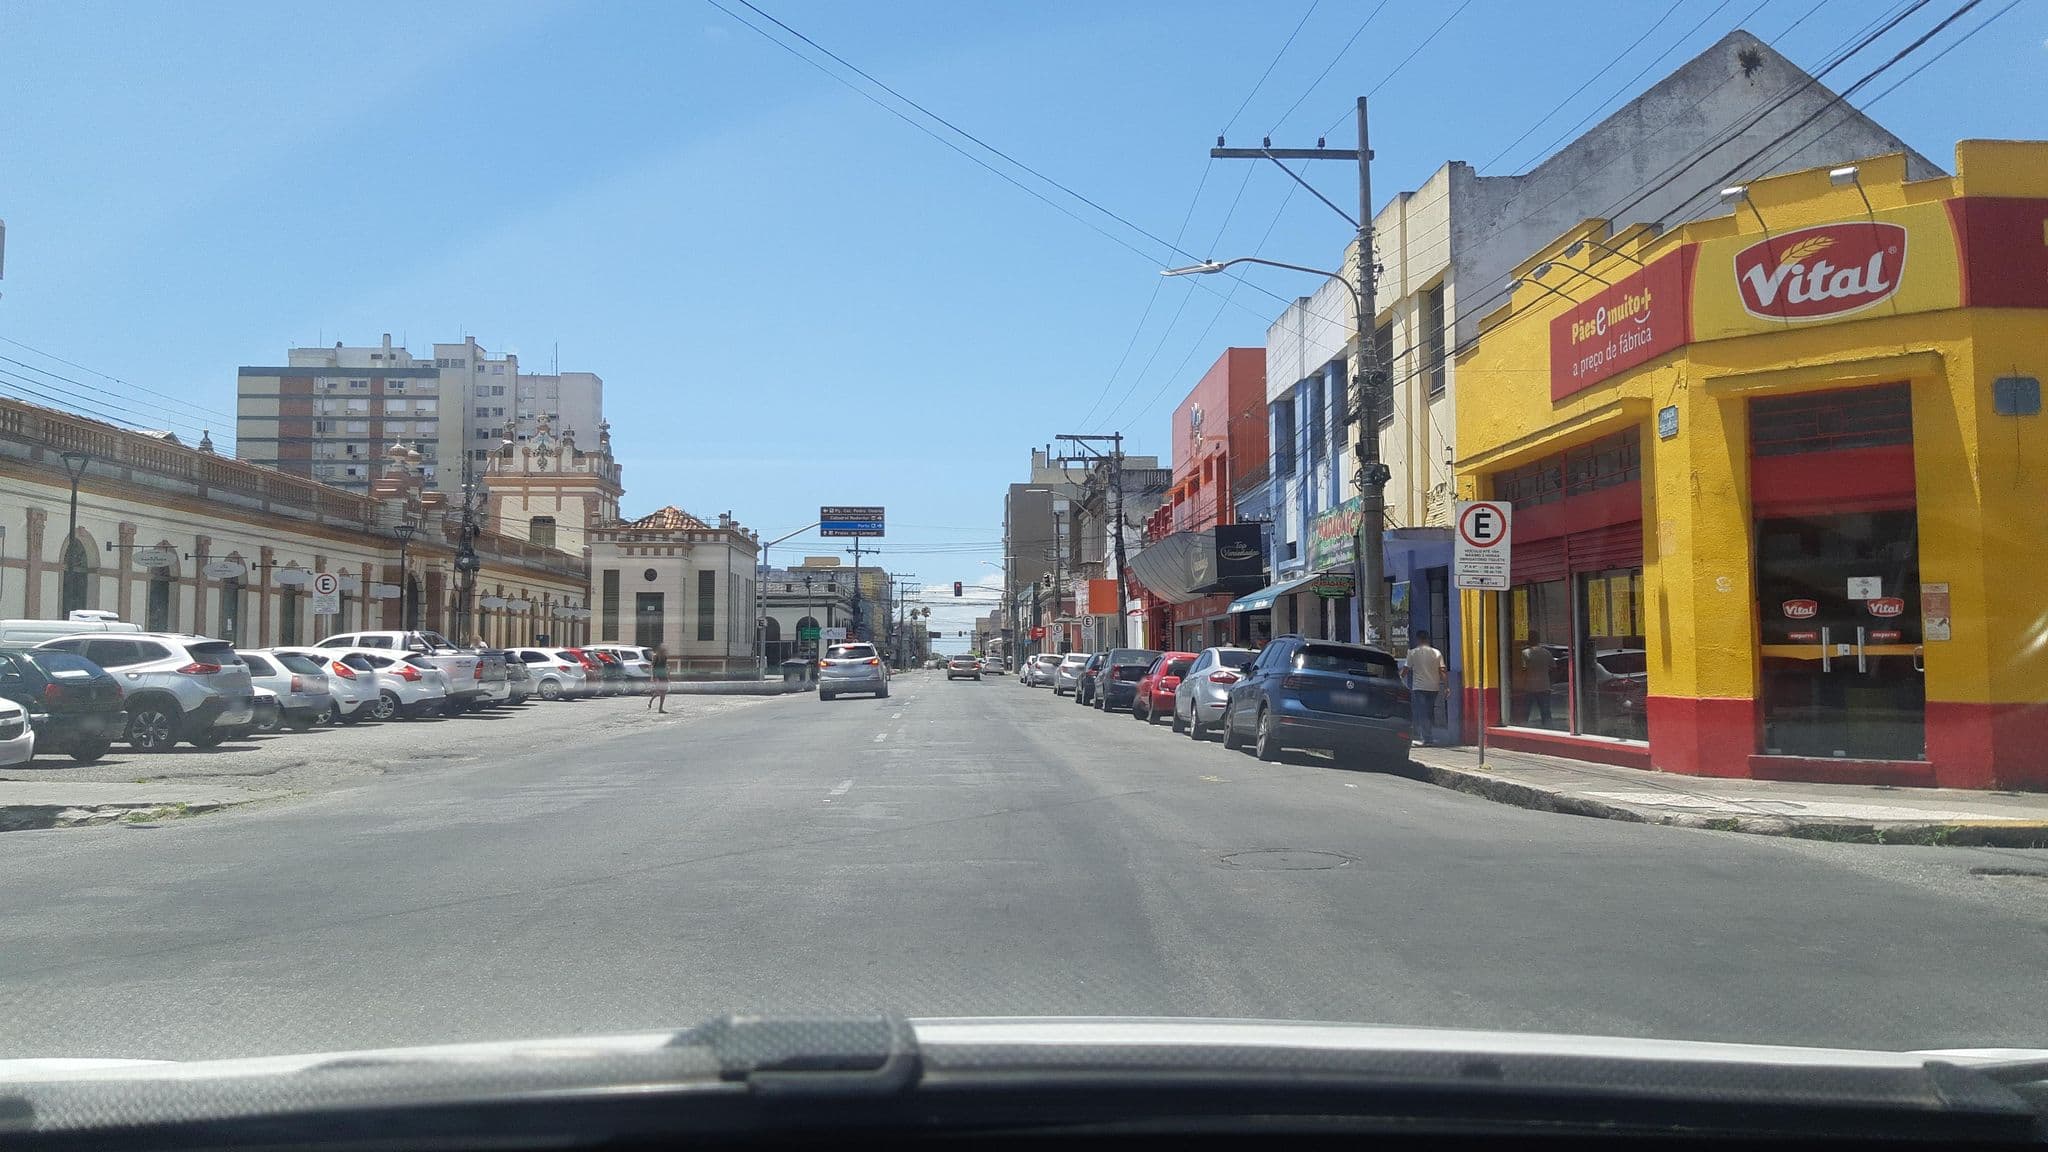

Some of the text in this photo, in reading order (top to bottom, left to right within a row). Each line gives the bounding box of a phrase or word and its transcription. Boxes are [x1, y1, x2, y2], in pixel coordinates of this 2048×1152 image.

[1743, 251, 1889, 307] Vital
[1572, 319, 1596, 345] Pães
[1596, 306, 1606, 336] e
[1573, 327, 1652, 378] a preço de fábrica
[1475, 513, 1491, 538] E
[322, 578, 330, 590] E
[1785, 605, 1814, 616] Vital
[1870, 604, 1899, 614] Vital
